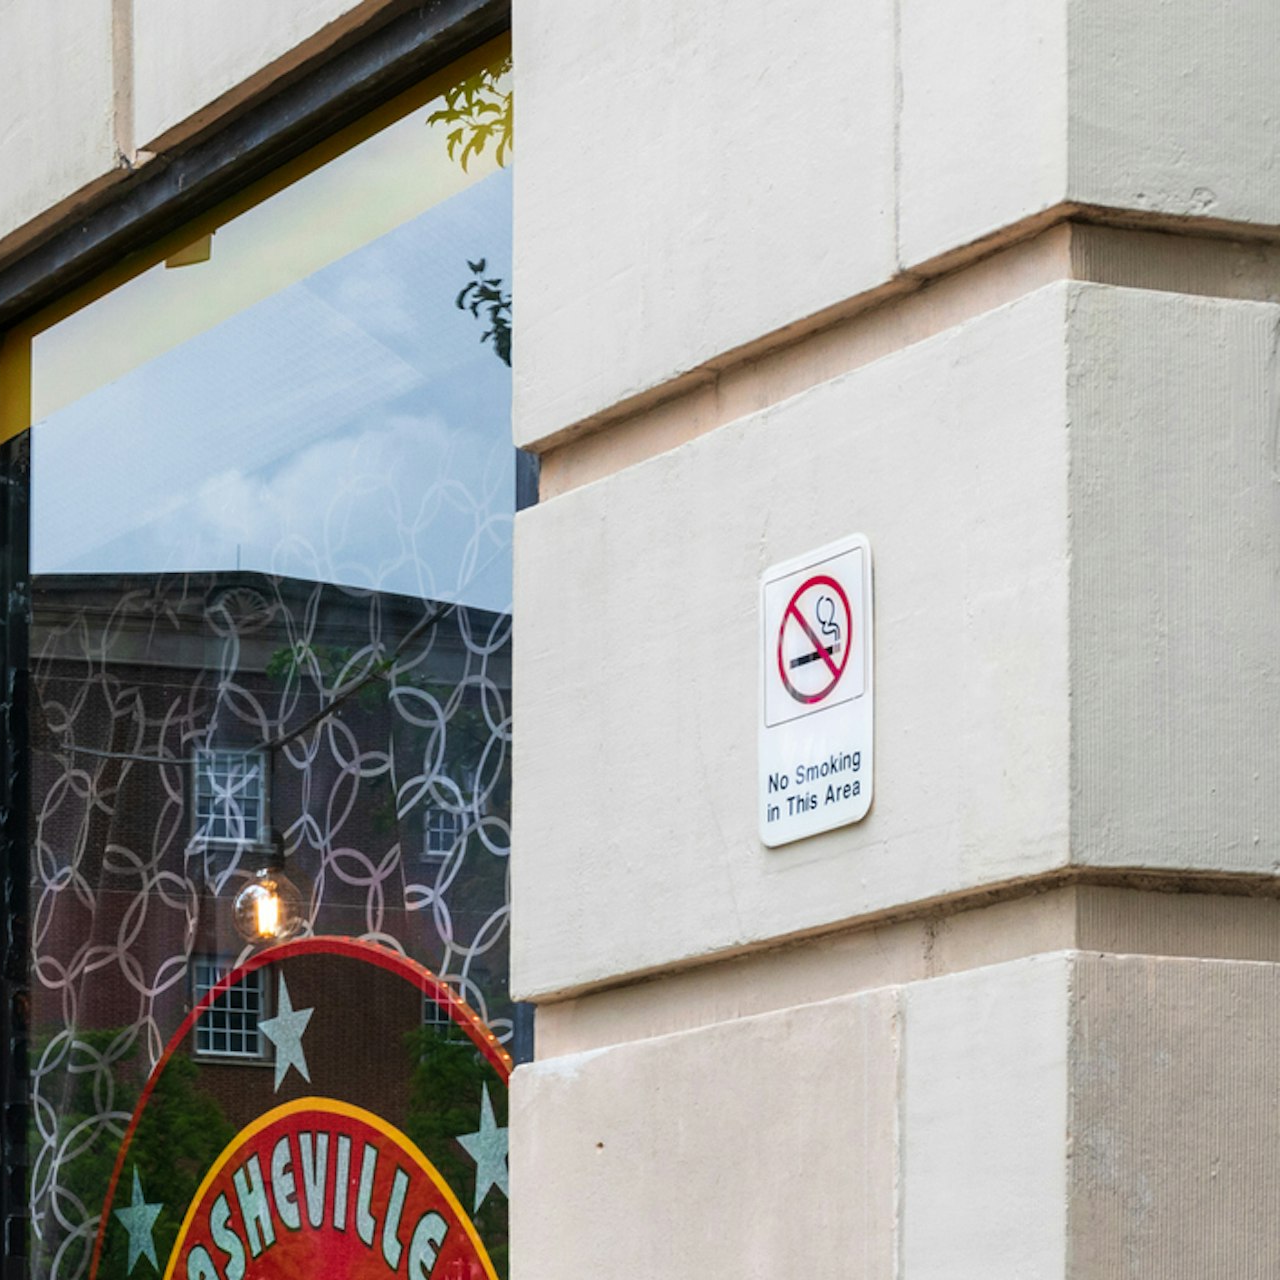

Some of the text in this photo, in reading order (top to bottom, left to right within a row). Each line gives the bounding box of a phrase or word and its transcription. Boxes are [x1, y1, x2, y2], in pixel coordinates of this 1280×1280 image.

[768, 751, 862, 794] No Smoking
[767, 780, 861, 823] in This Area
